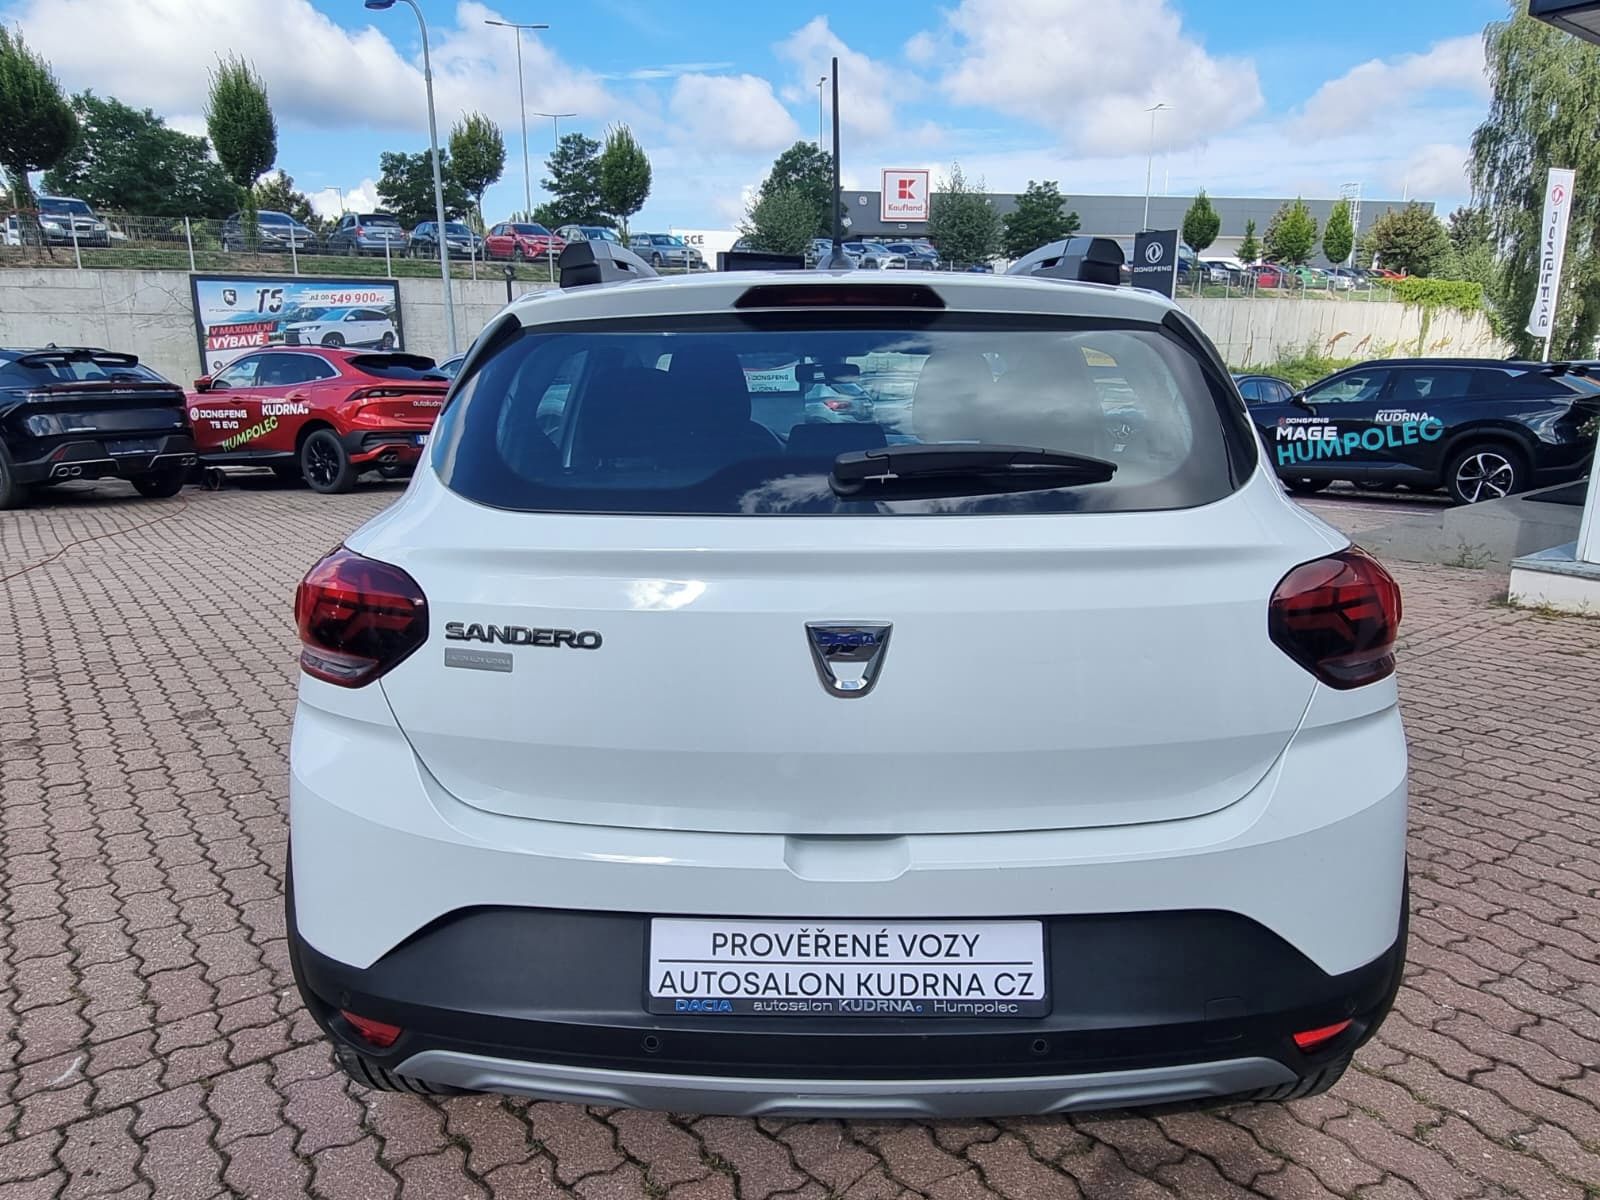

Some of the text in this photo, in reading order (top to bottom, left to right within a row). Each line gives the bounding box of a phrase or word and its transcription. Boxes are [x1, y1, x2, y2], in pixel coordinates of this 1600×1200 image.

[888, 203, 923, 212] Kaufland
[683, 234, 705, 245] SCE
[1133, 265, 1172, 273] DONGFENG
[330, 293, 352, 305] 549
[354, 292, 376, 304] 900
[219, 321, 274, 335] MAXIMÁLNÍ
[212, 332, 264, 349] VÝBAVĚ
[200, 409, 247, 419] DONGFENG
[222, 421, 239, 429] EVO
[222, 416, 279, 453] HUMPOLEC
[1276, 426, 1338, 441] MAGE
[1277, 418, 1443, 466] HUMPOLEC
[445, 621, 603, 650] SANDERO
[711, 928, 981, 958] PROVĚŘENÉ VOZY
[658, 970, 1035, 998] AUTOSALON KUDRNA CZ
[674, 999, 734, 1013] DACIA
[753, 999, 833, 1013] autosalon
[933, 1000, 1019, 1015] Humpolec
